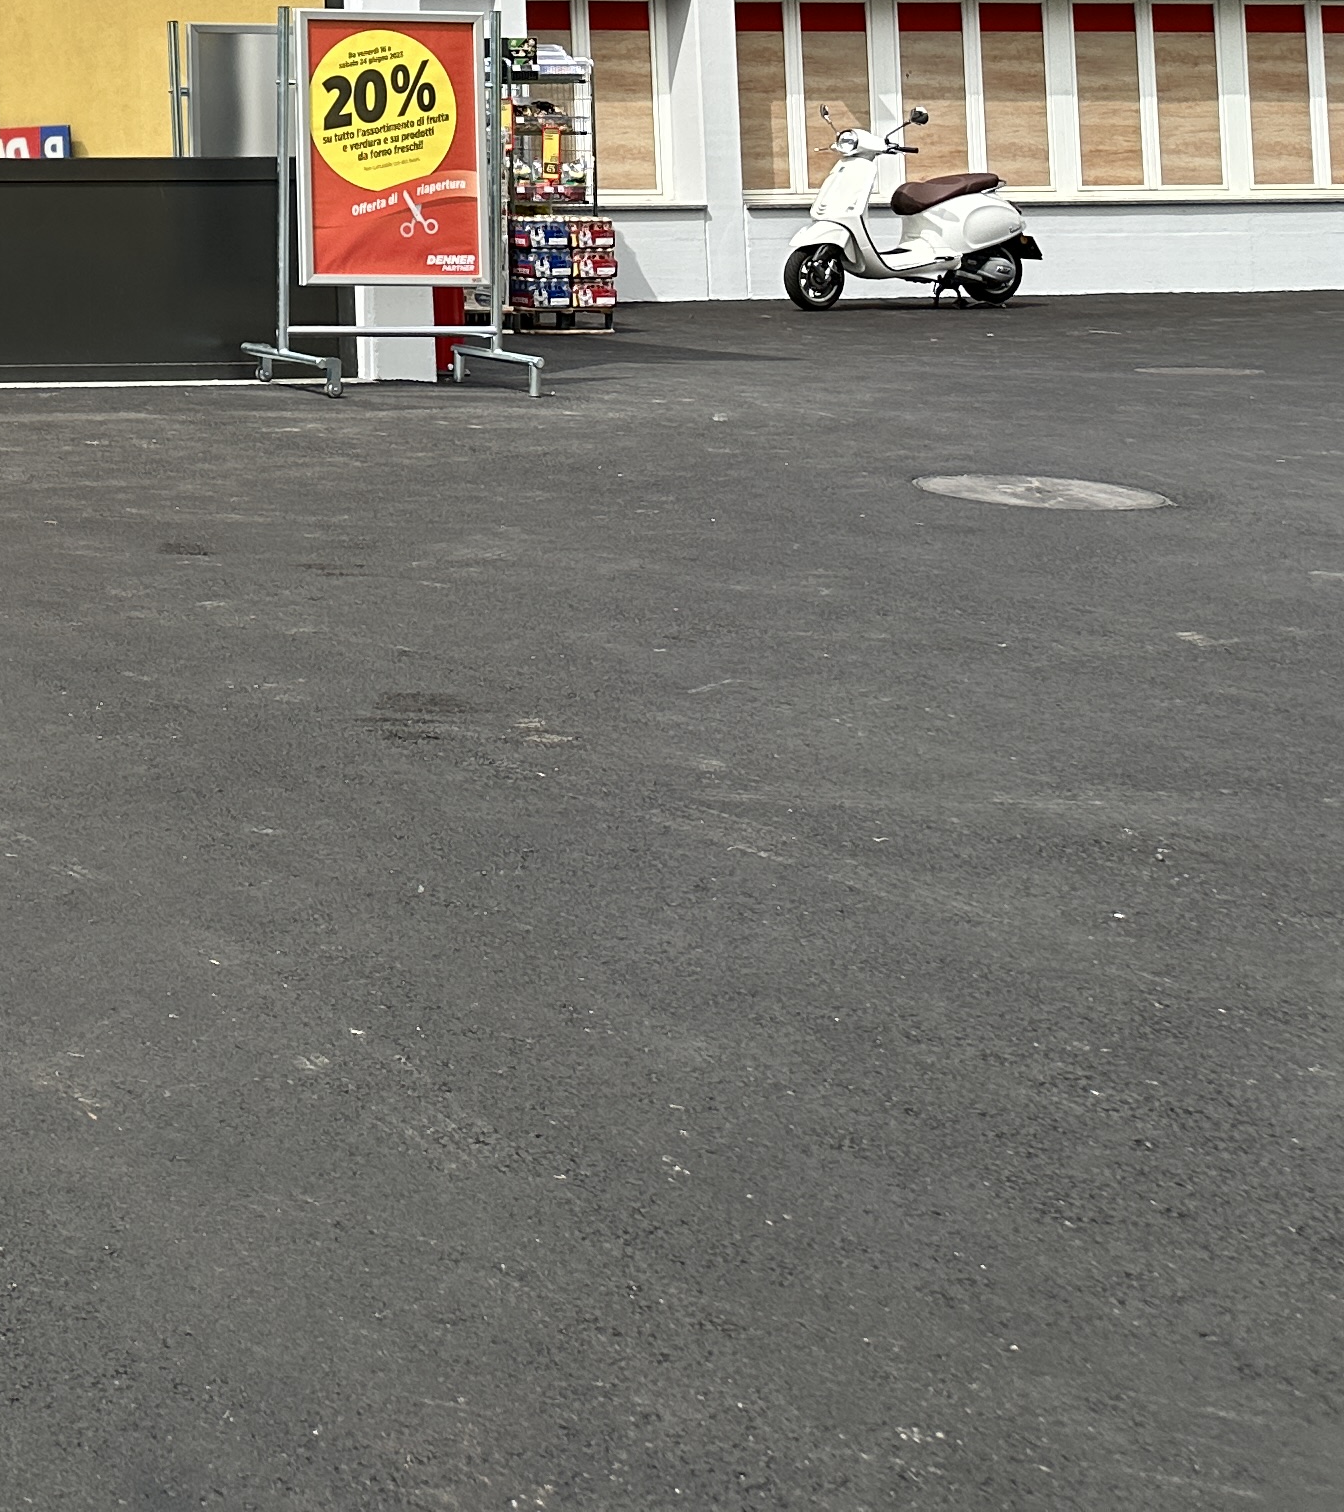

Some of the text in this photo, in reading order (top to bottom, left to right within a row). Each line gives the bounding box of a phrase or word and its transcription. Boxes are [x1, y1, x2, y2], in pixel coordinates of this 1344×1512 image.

[321, 58, 437, 131] 20%
[323, 136, 332, 144] su
[334, 131, 355, 142] tutto
[416, 116, 425, 126] di
[426, 112, 450, 125] frutta
[350, 139, 381, 151] verdura
[390, 134, 399, 142] su
[401, 126, 435, 141] prodotti
[357, 151, 368, 161] da
[370, 147, 392, 159] forno
[417, 180, 466, 196] riapertura
[352, 192, 398, 216] Offerta di
[426, 255, 475, 265] DENNER
